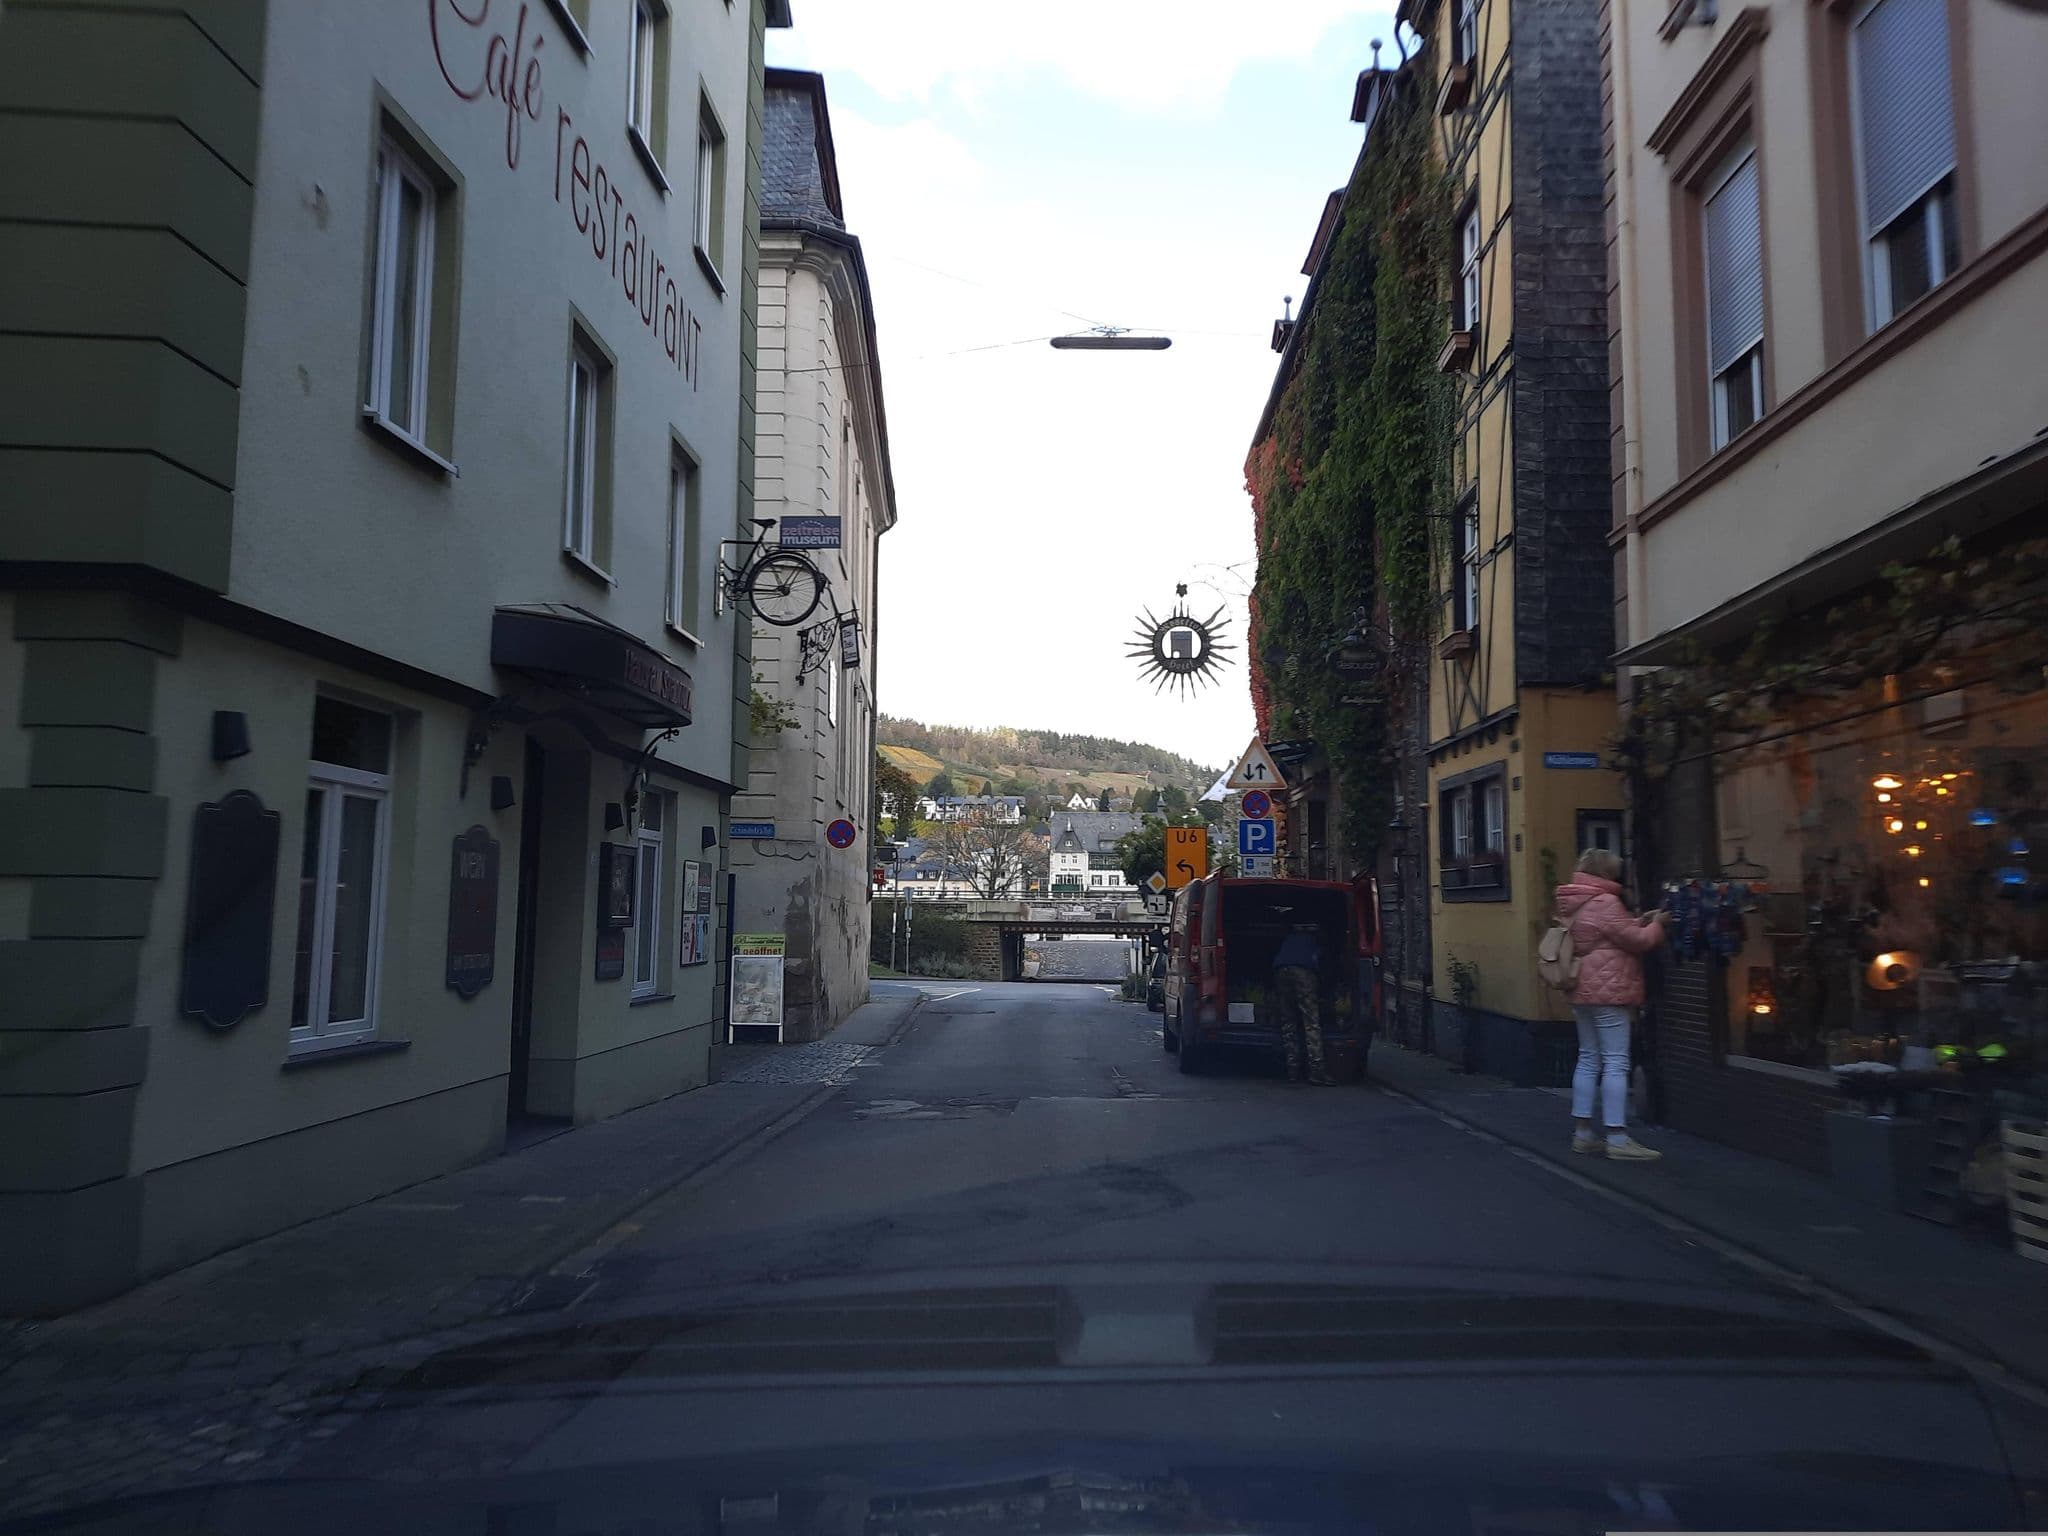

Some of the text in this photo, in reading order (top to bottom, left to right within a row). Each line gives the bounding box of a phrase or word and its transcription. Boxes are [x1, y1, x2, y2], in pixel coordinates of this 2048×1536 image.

[782, 526, 839, 536] zeitreise
[782, 536, 839, 545] museum
[1246, 824, 1266, 850] P
